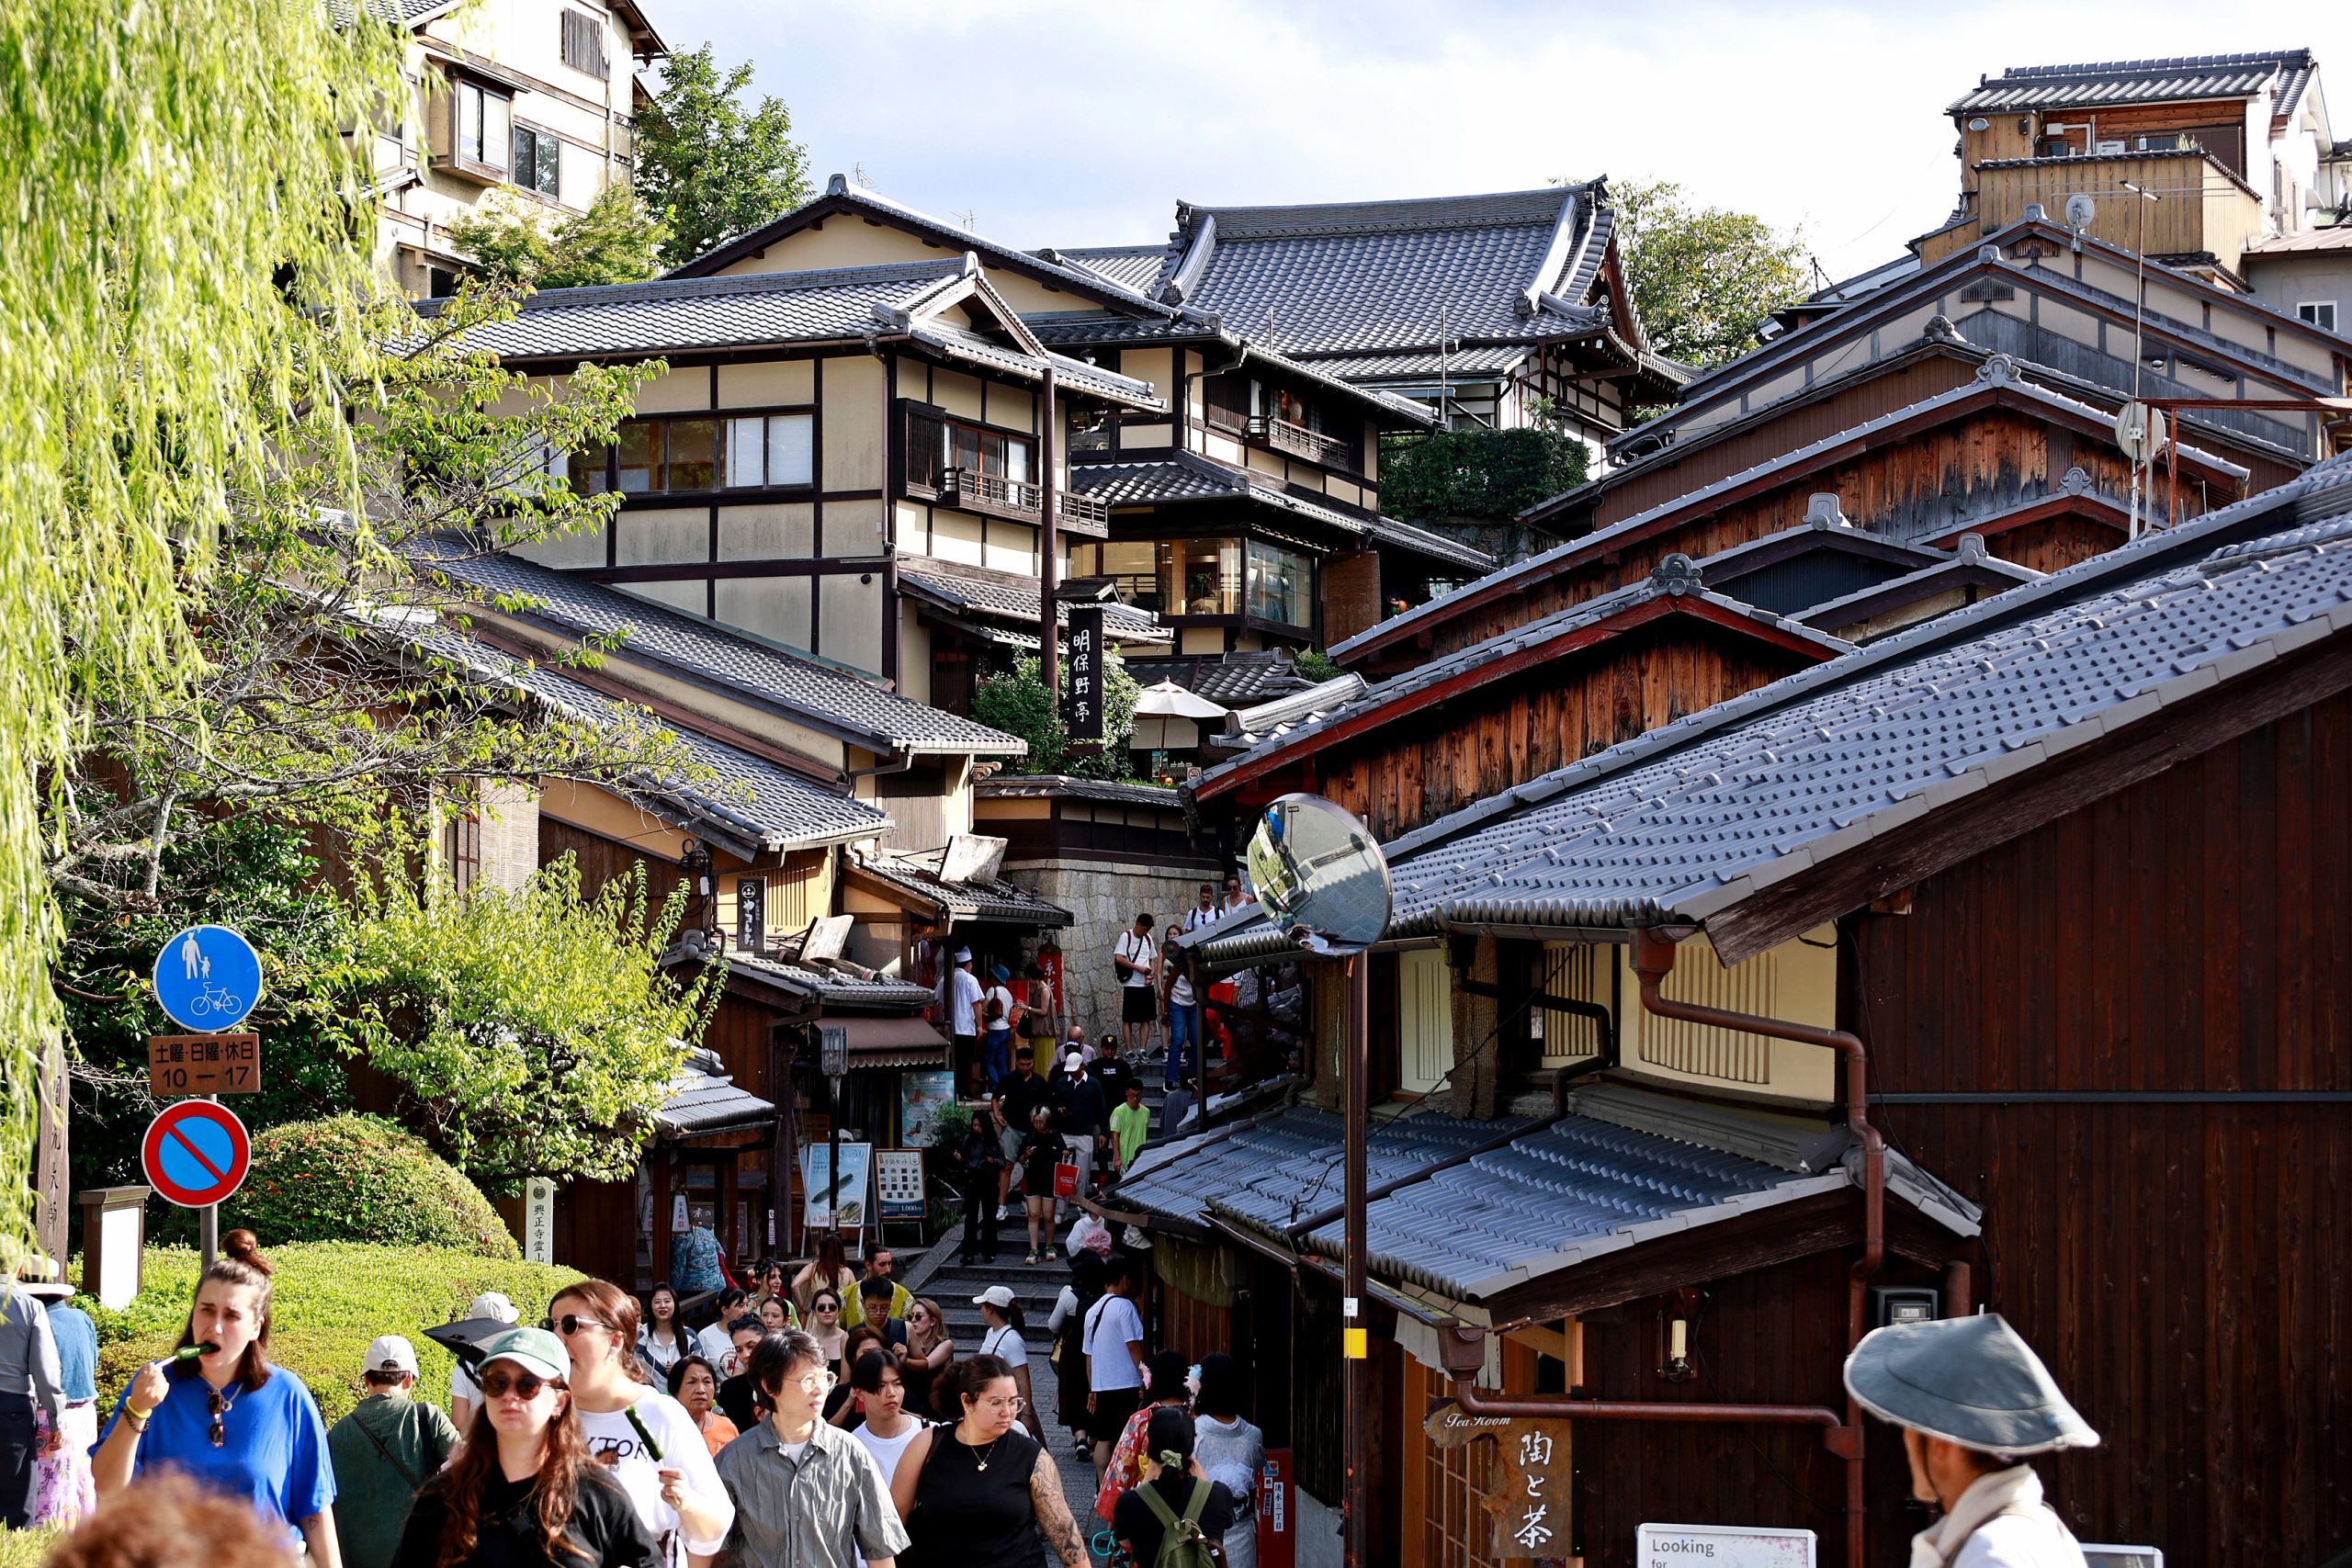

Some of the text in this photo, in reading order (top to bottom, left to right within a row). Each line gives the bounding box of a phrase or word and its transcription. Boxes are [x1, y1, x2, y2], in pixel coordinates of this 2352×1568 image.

[1073, 628, 1091, 723] 明保野亭
[155, 1041, 254, 1064] 土曜・日曜・休日
[162, 1067, 187, 1089] 10
[224, 1066, 250, 1086] 17
[1444, 1413, 1470, 1427] Tea
[1514, 1430, 1553, 1550] 陶と茶
[1652, 1539, 1714, 1558] Looking
